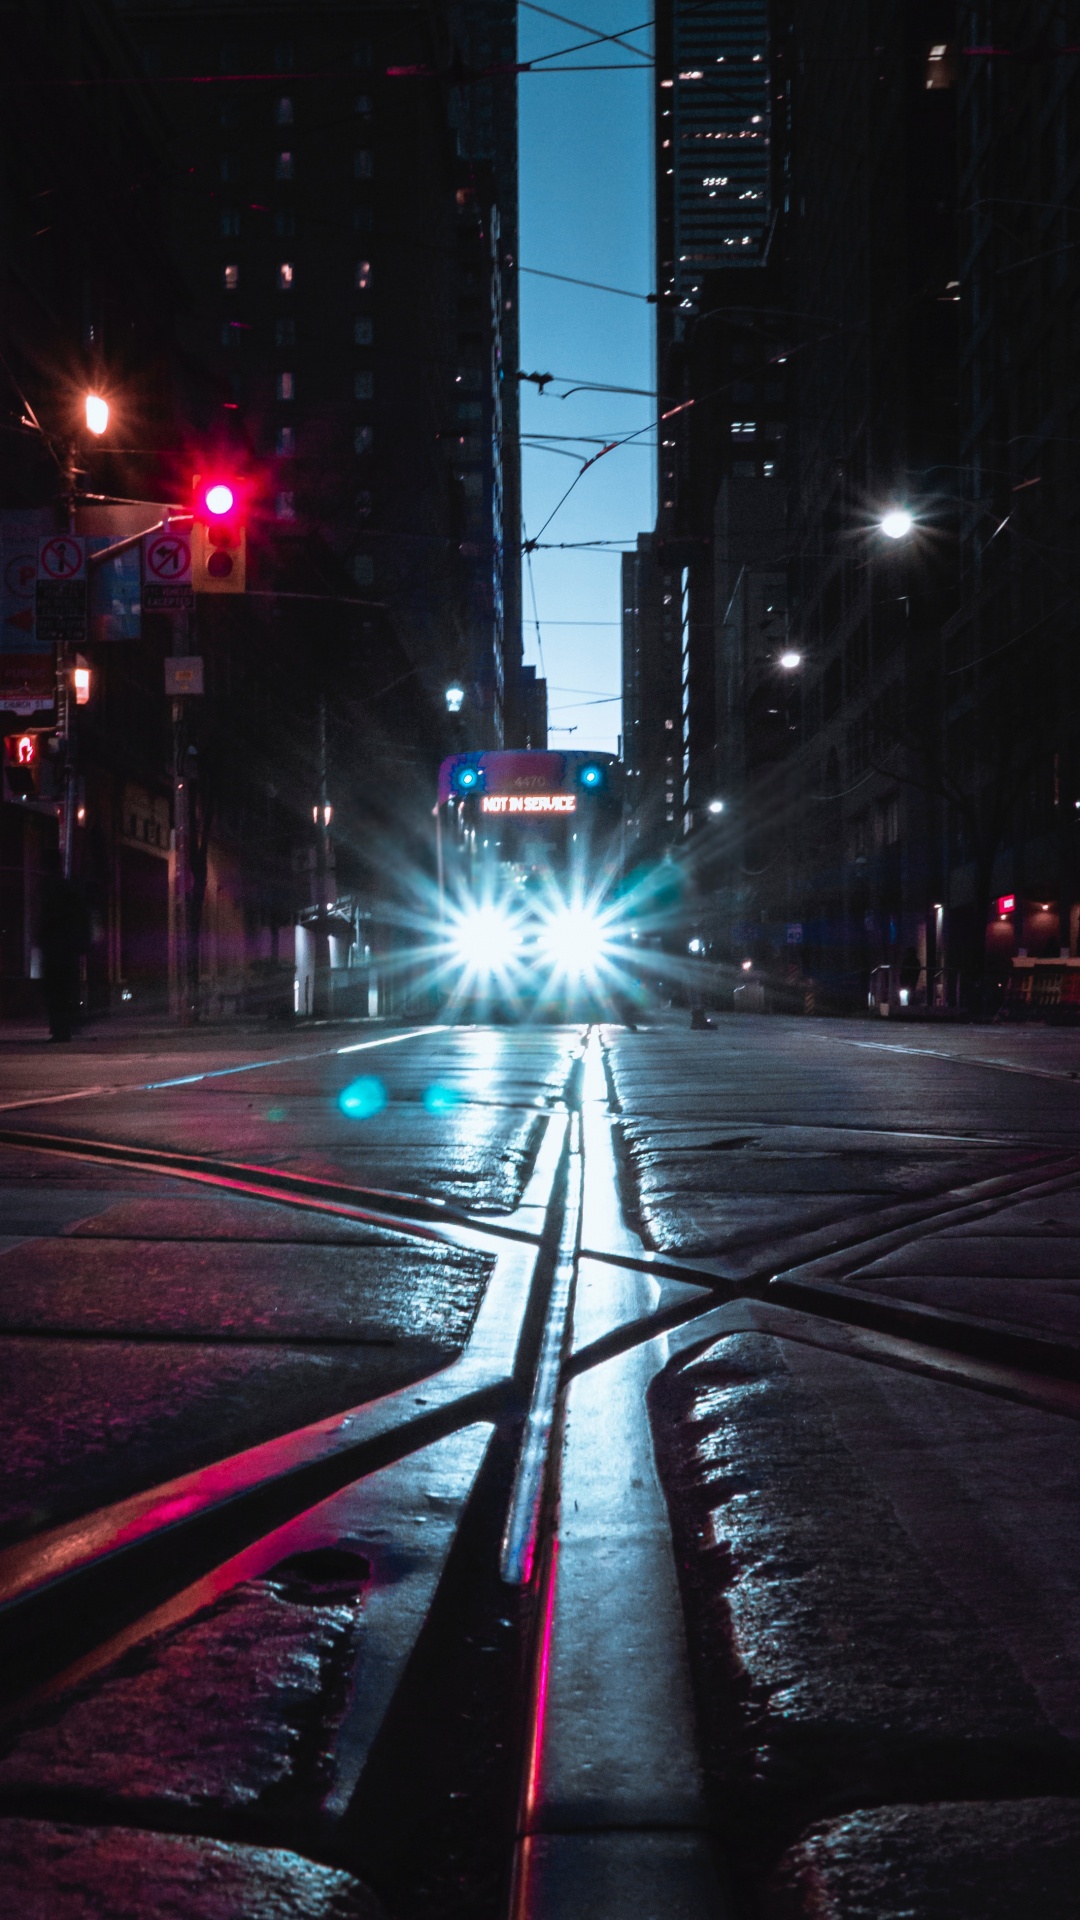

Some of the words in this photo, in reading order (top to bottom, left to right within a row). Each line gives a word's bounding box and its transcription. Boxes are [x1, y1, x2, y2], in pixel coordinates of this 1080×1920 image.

[514, 775, 546, 788] 4470
[483, 796, 507, 812] NOT
[508, 796, 523, 812] IN
[524, 796, 574, 811] SERVICE
